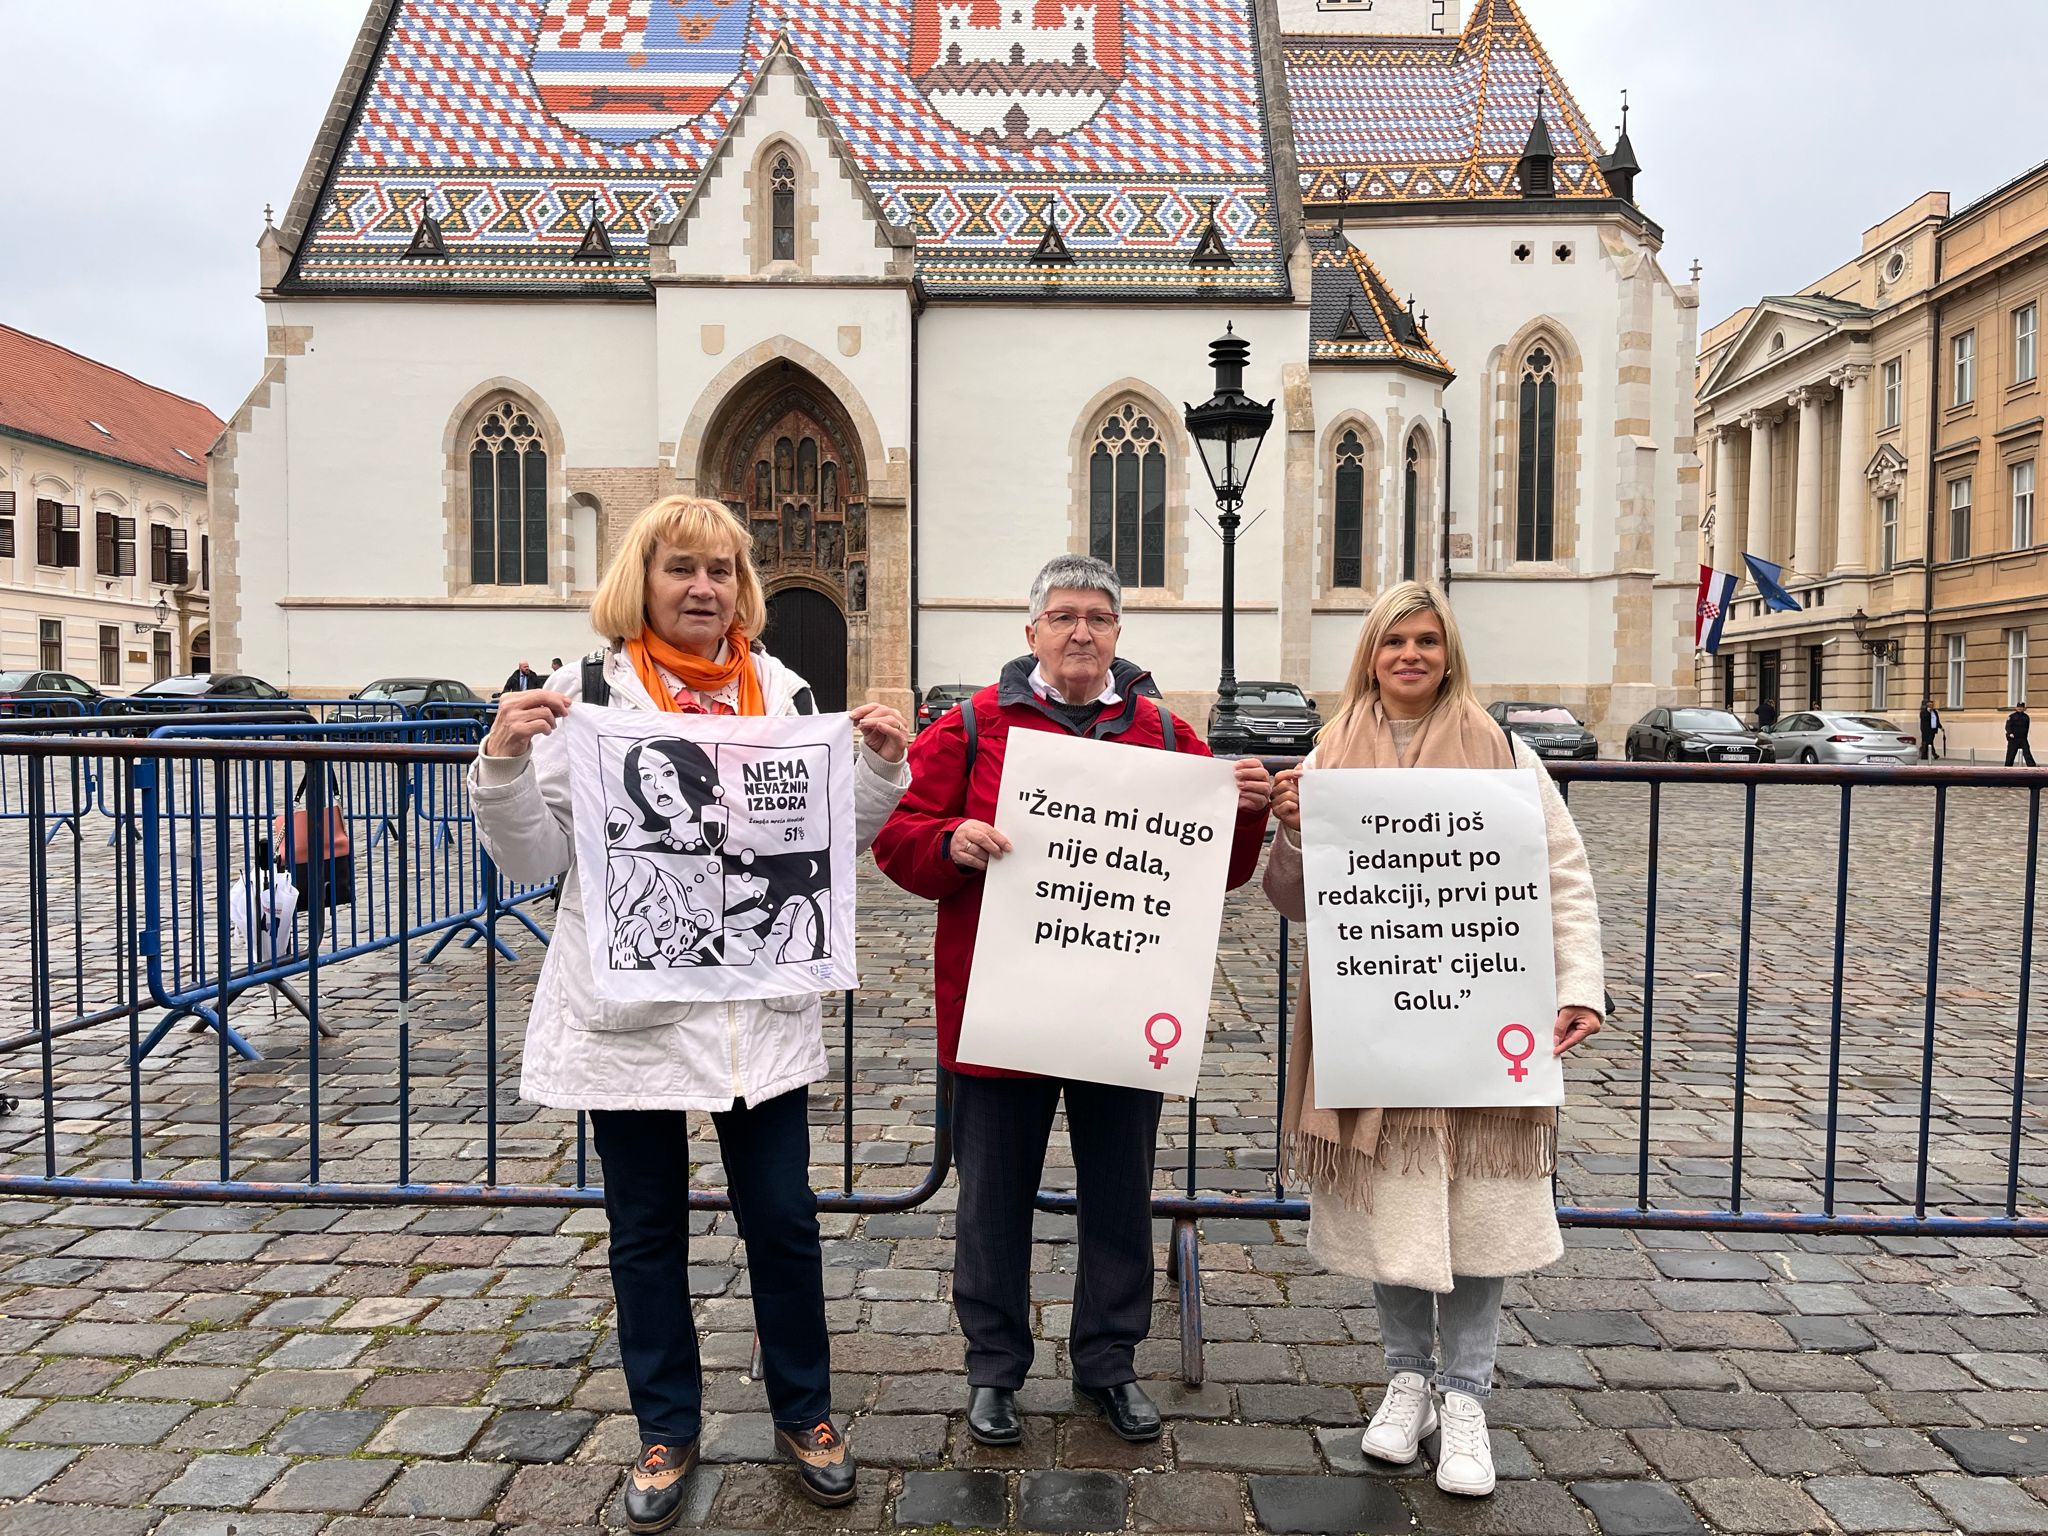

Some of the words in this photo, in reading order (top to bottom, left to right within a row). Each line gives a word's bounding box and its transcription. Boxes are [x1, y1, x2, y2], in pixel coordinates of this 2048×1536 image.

[742, 759, 809, 782] NEMA
[744, 779, 808, 795] NEVAŽNIH
[747, 796, 807, 811] IZBORA
[1019, 788, 1096, 825] "Žena
[1104, 808, 1139, 831] mi
[1145, 812, 1214, 846] dugo
[1447, 811, 1485, 838] još
[1048, 838, 1098, 868] nije
[1105, 846, 1171, 882] dala,
[1347, 849, 1462, 876] jedanput
[1469, 849, 1501, 872] po
[1035, 879, 1135, 911] smijem
[1143, 894, 1172, 917] te
[1318, 882, 1431, 909] redakciji,
[1438, 881, 1487, 908] prvi
[1495, 882, 1539, 907] put
[1034, 918, 1161, 954] pipkati?"
[1337, 922, 1363, 941] te
[1370, 919, 1443, 940] nisam
[1451, 916, 1520, 943] uspio
[1336, 954, 1443, 976] skenirat'
[1450, 952, 1526, 979] cijelu.
[1393, 989, 1472, 1011] Golu.”
